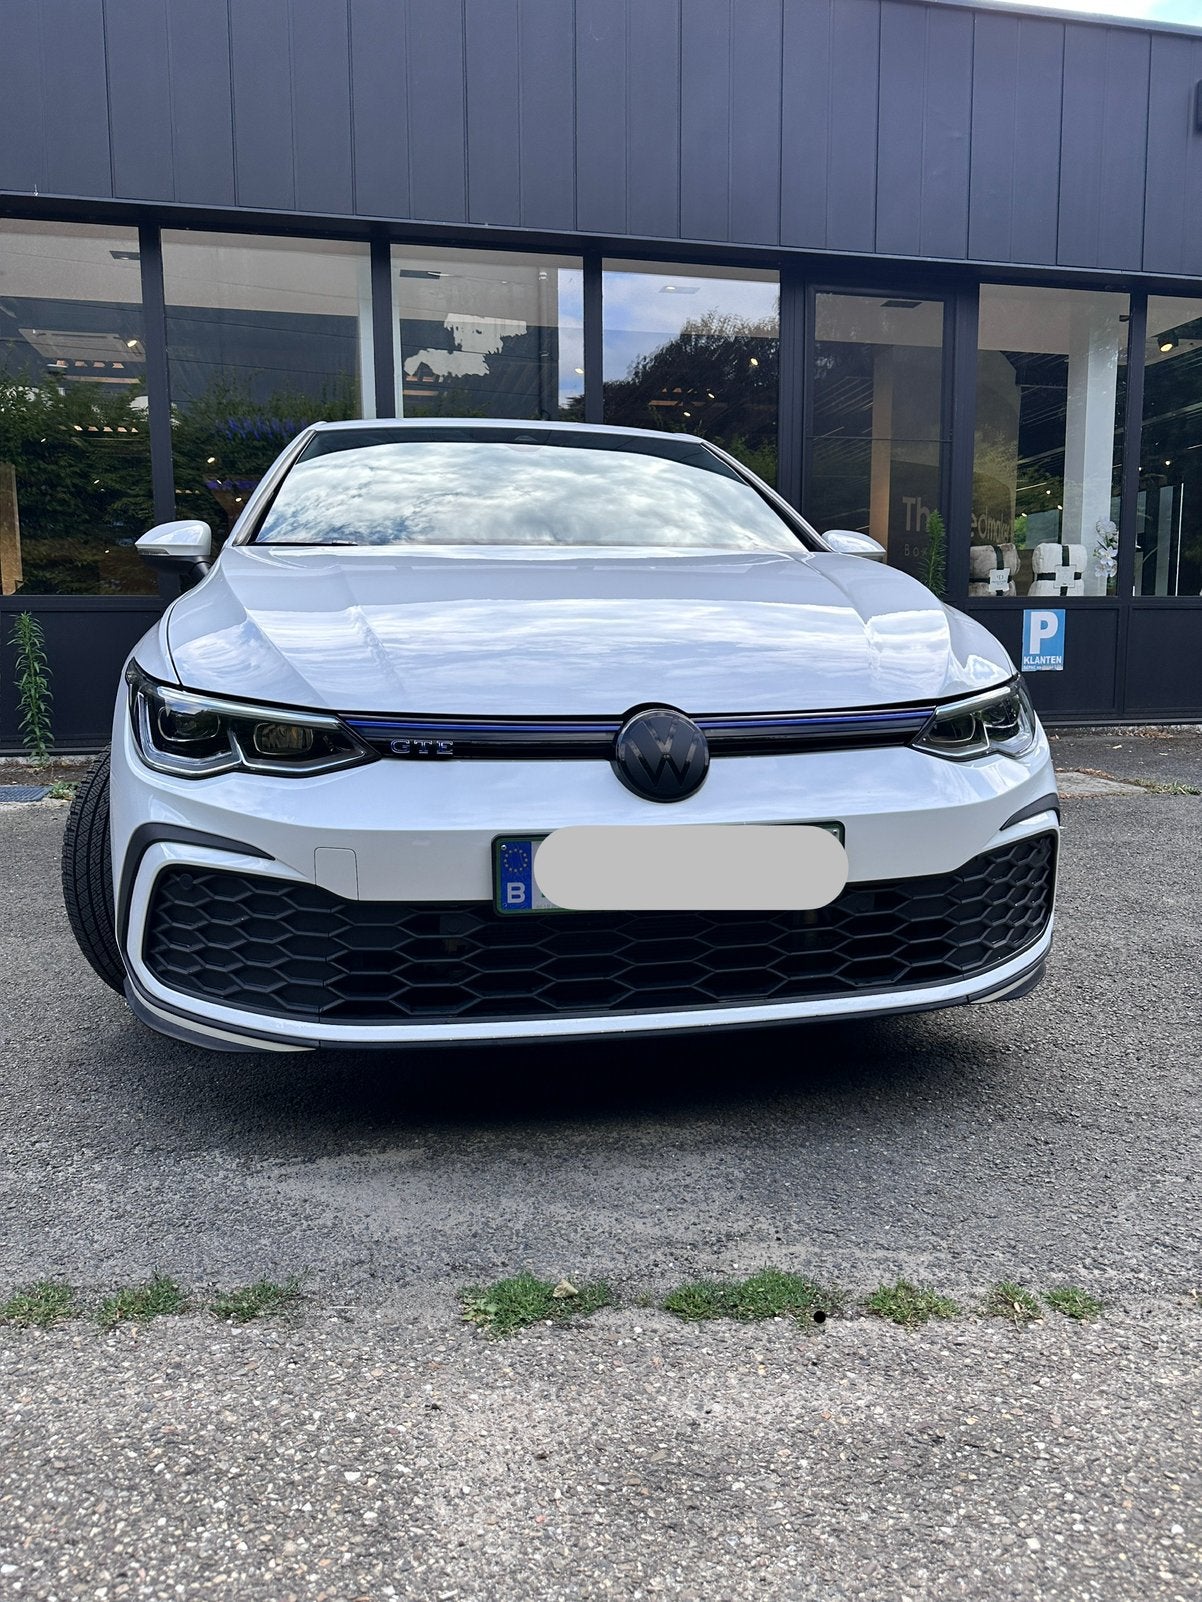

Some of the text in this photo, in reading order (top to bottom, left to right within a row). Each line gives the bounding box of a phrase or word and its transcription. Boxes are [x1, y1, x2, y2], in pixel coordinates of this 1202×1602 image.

[902, 496, 931, 532] Th
[1029, 611, 1058, 654] P
[1023, 655, 1062, 664] KLANTEN
[390, 739, 454, 755] GTE
[506, 881, 526, 903] B
